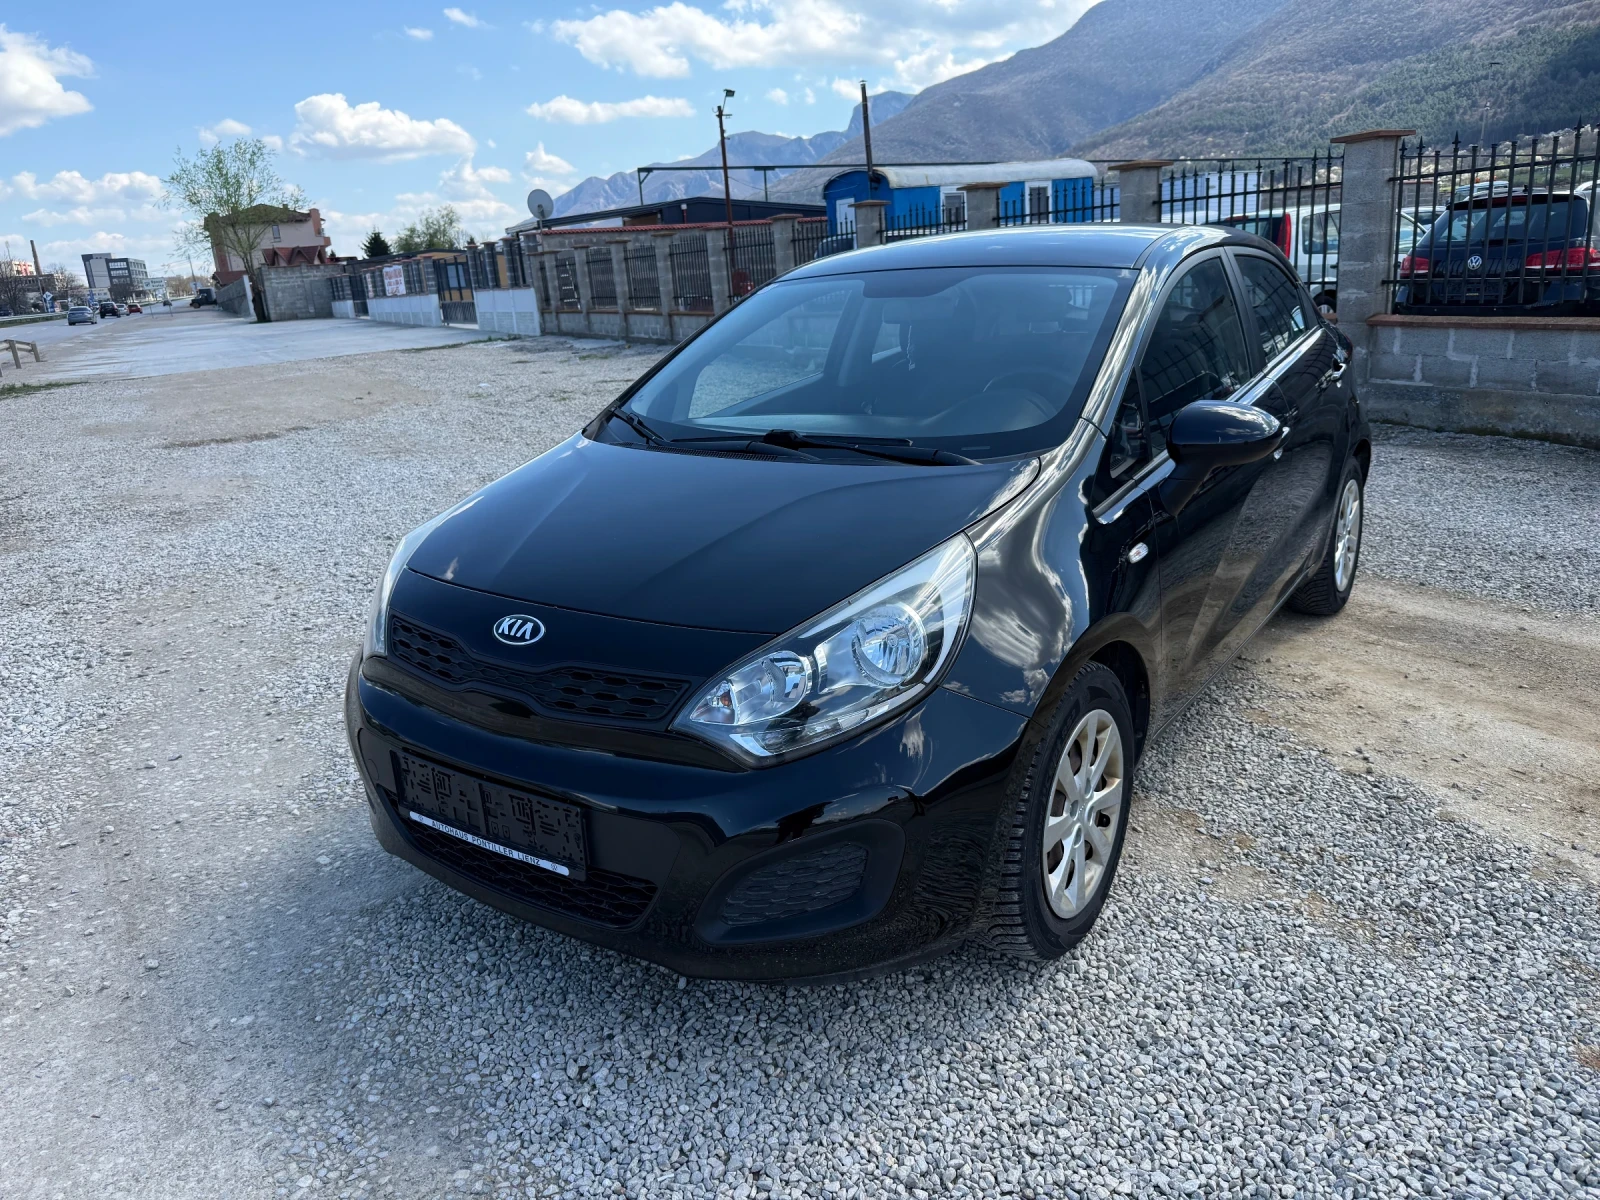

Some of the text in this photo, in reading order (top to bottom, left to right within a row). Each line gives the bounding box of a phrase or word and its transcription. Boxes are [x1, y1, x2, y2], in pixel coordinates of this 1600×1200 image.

[1468, 255, 1482, 270] VW
[498, 617, 534, 640] KIA
[431, 820, 541, 866] AUTOHAUS PONTILLER LIENZ
